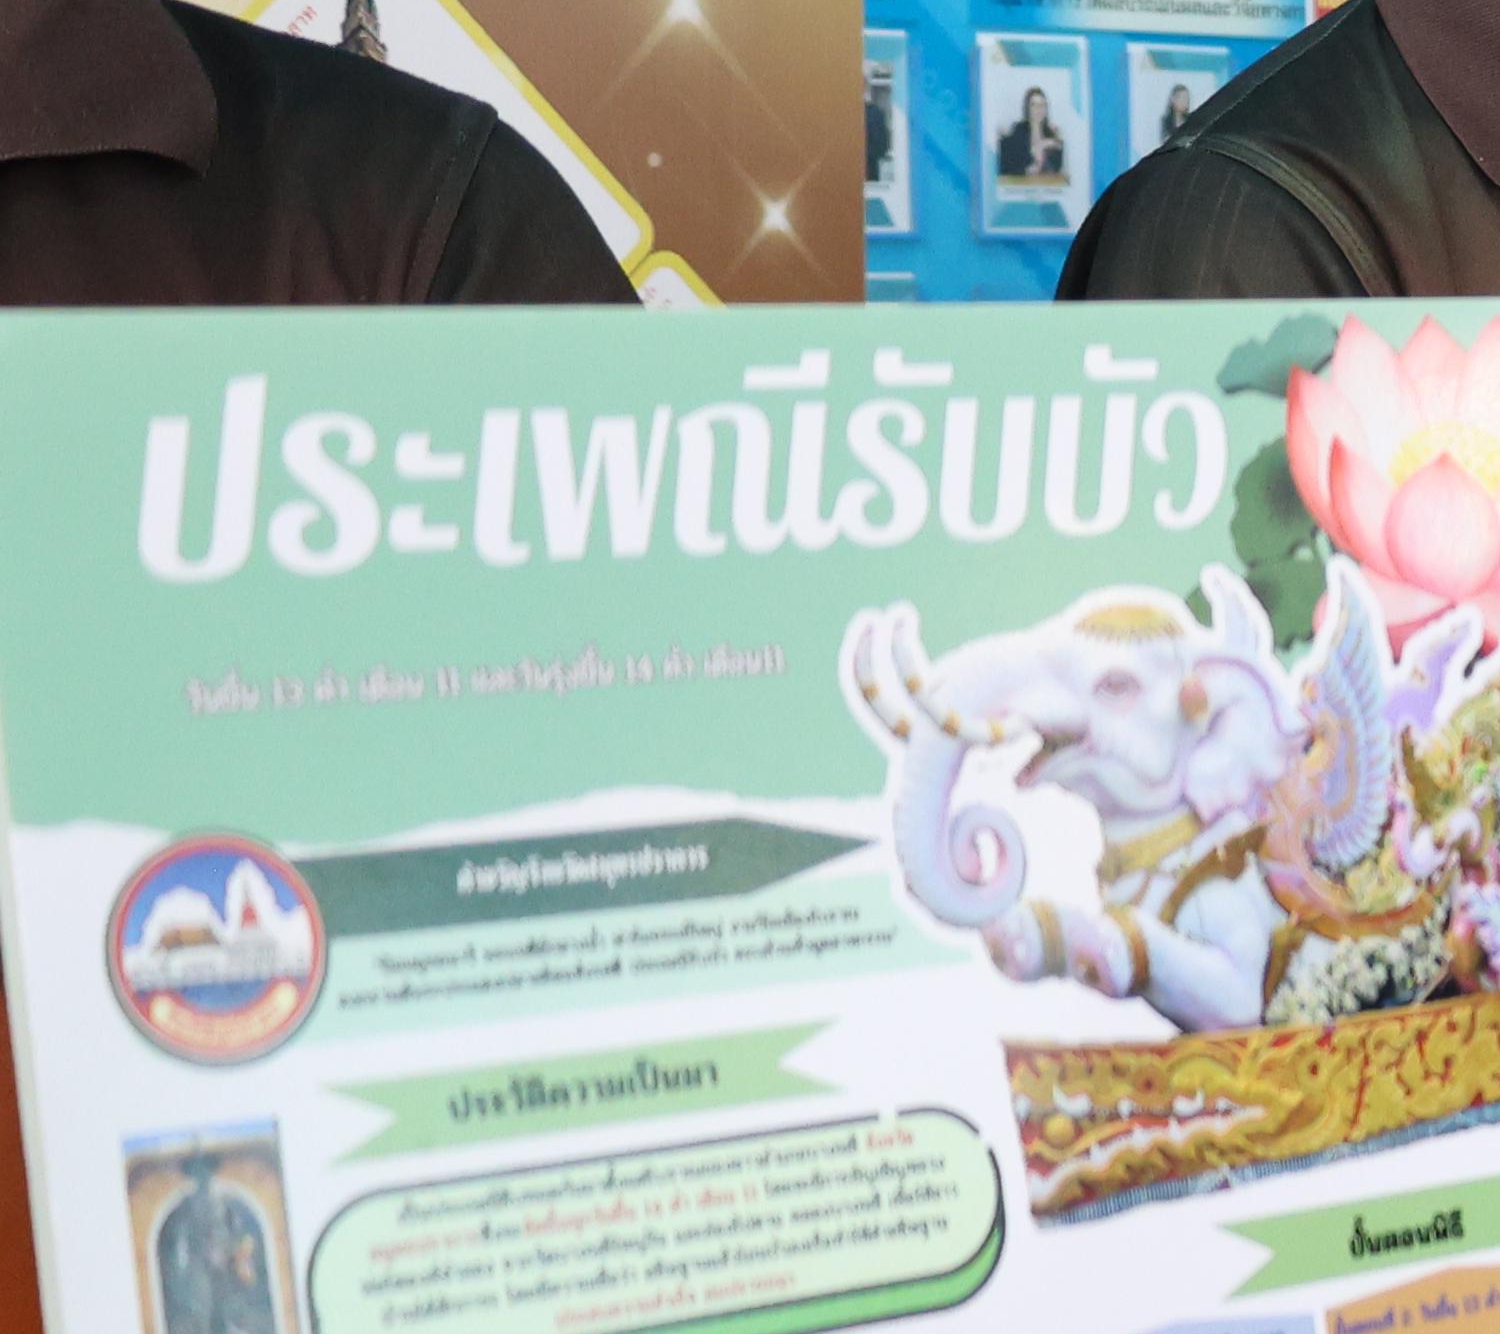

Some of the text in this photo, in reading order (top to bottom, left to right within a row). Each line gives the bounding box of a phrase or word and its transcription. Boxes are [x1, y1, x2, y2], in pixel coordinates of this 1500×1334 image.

[137, 343, 1228, 585] ประเพณีรับบัว
